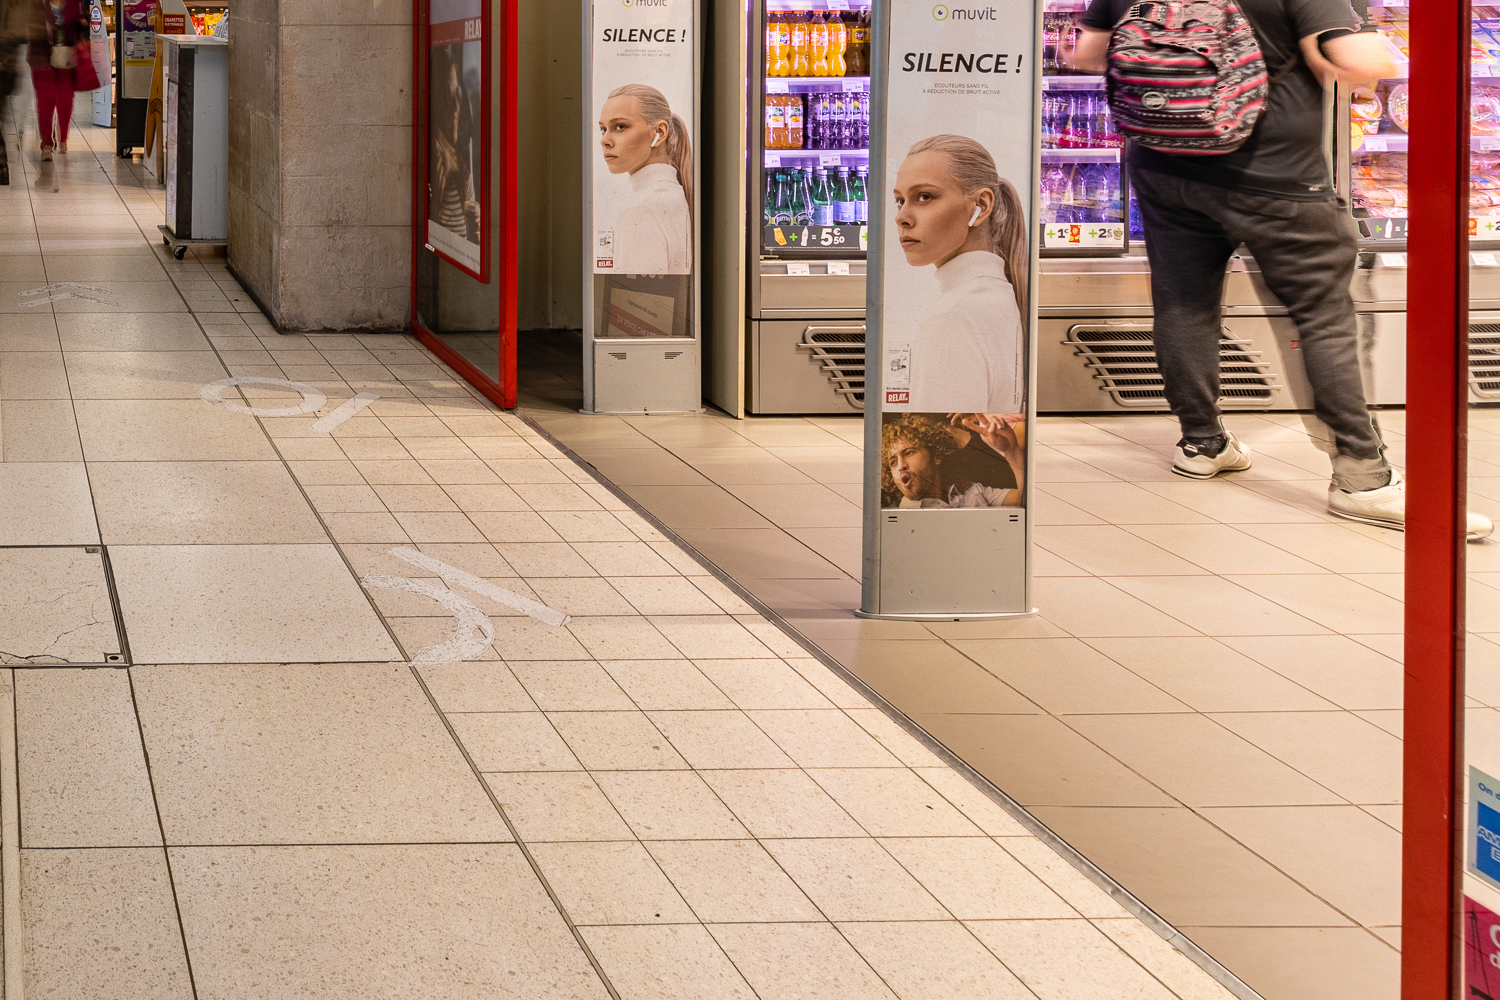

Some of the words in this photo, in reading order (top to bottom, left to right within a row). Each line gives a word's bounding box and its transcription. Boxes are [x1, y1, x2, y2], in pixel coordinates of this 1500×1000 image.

[952, 7, 997, 20] muvit
[465, 19, 481, 40] RELAY
[602, 28, 676, 42] SILENCE
[681, 29, 686, 42] !
[902, 52, 1008, 74] SILENCE
[1015, 54, 1023, 74] !
[888, 392, 905, 402] RELAY
[1478, 782, 1493, 797] On
